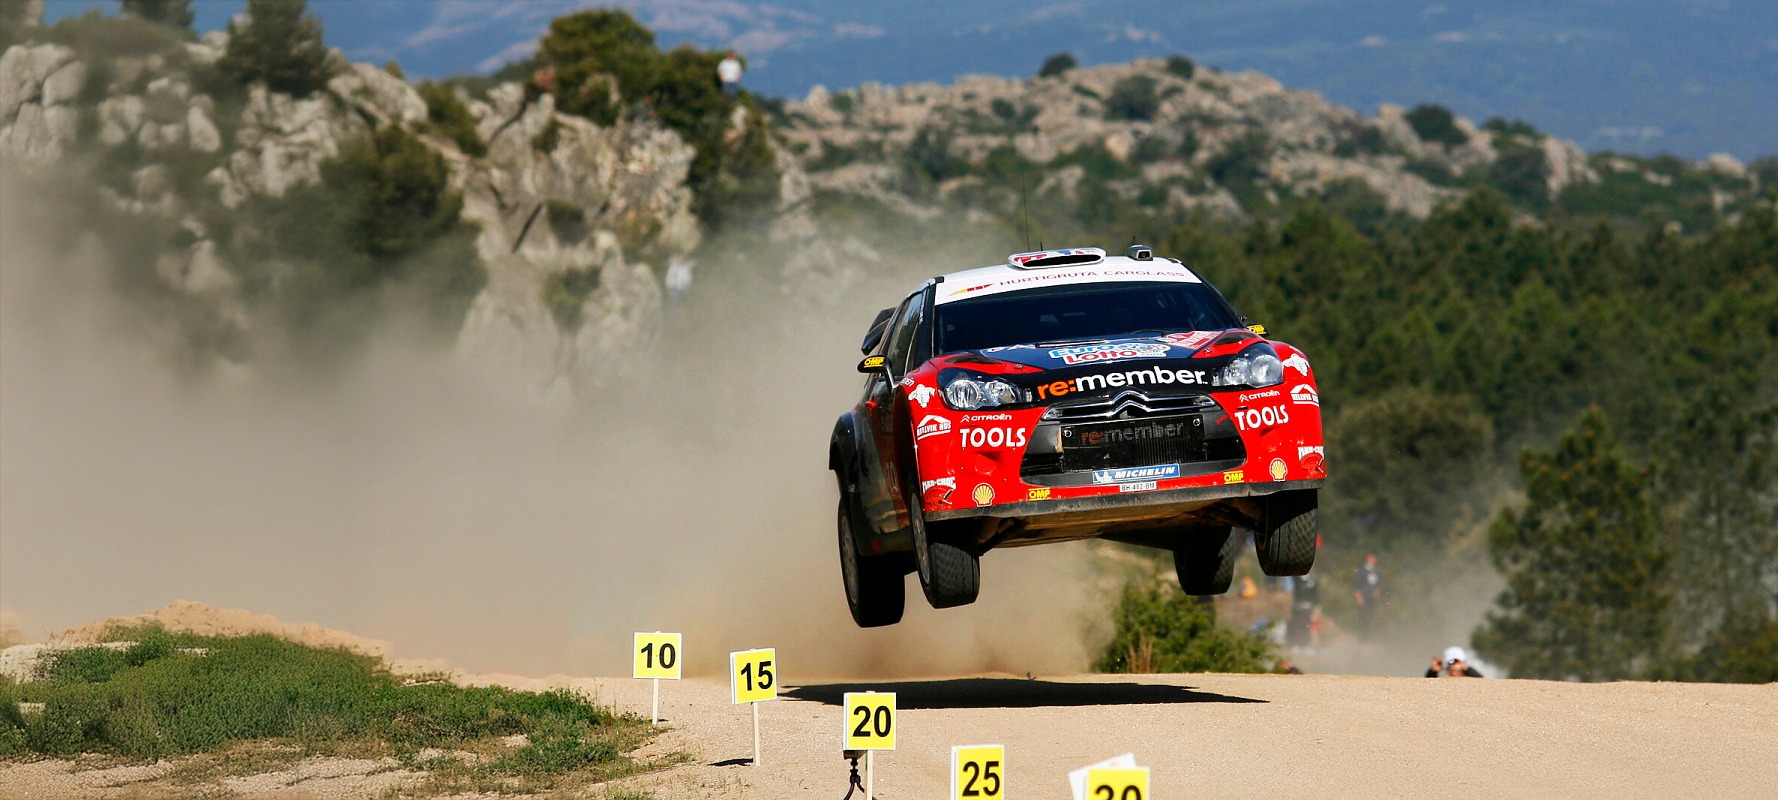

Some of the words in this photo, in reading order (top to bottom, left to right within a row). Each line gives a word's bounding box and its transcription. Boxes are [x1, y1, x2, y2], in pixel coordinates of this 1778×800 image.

[1000, 271, 1097, 286] HURTIGRUTA
[864, 357, 884, 366] OMP
[1037, 366, 1206, 400] re:member
[1234, 404, 1289, 431] TOOLS
[960, 427, 1026, 447] TOOLS
[1115, 466, 1176, 478] MICHELIN
[1224, 472, 1244, 482] OMP
[1029, 489, 1050, 499] OMP
[641, 643, 676, 669] 10
[741, 661, 773, 692] 15
[852, 706, 892, 738] 20
[962, 760, 1000, 797] 25
